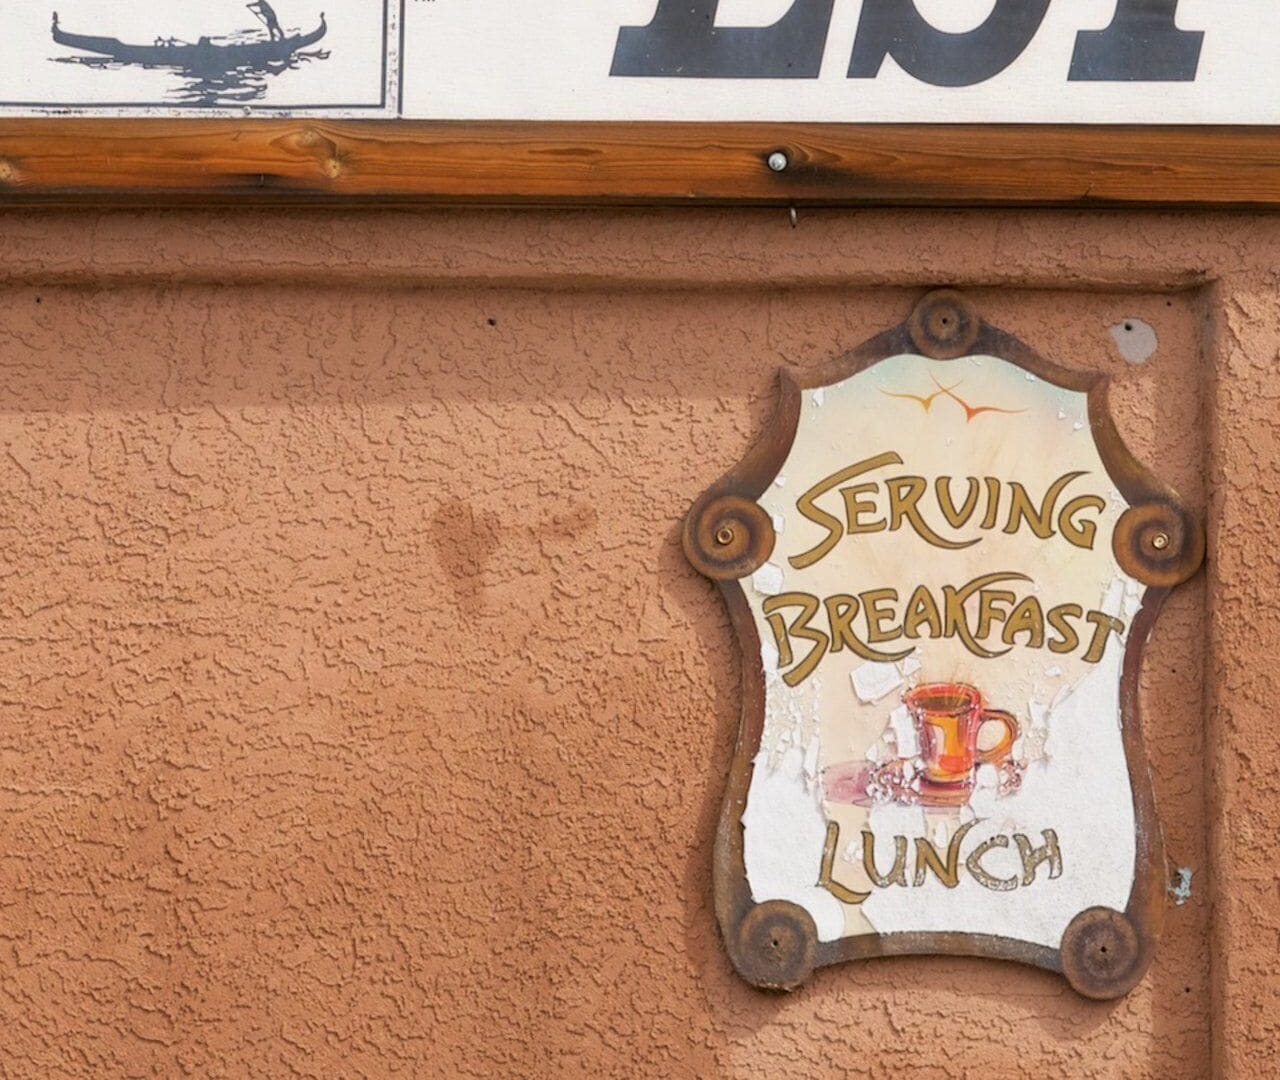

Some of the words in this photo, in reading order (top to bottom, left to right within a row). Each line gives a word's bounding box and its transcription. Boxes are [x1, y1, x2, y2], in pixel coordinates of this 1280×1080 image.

[788, 451, 1107, 570] SERVING
[762, 572, 1126, 688] BREAKFAST
[815, 819, 1063, 905] LUNCH
